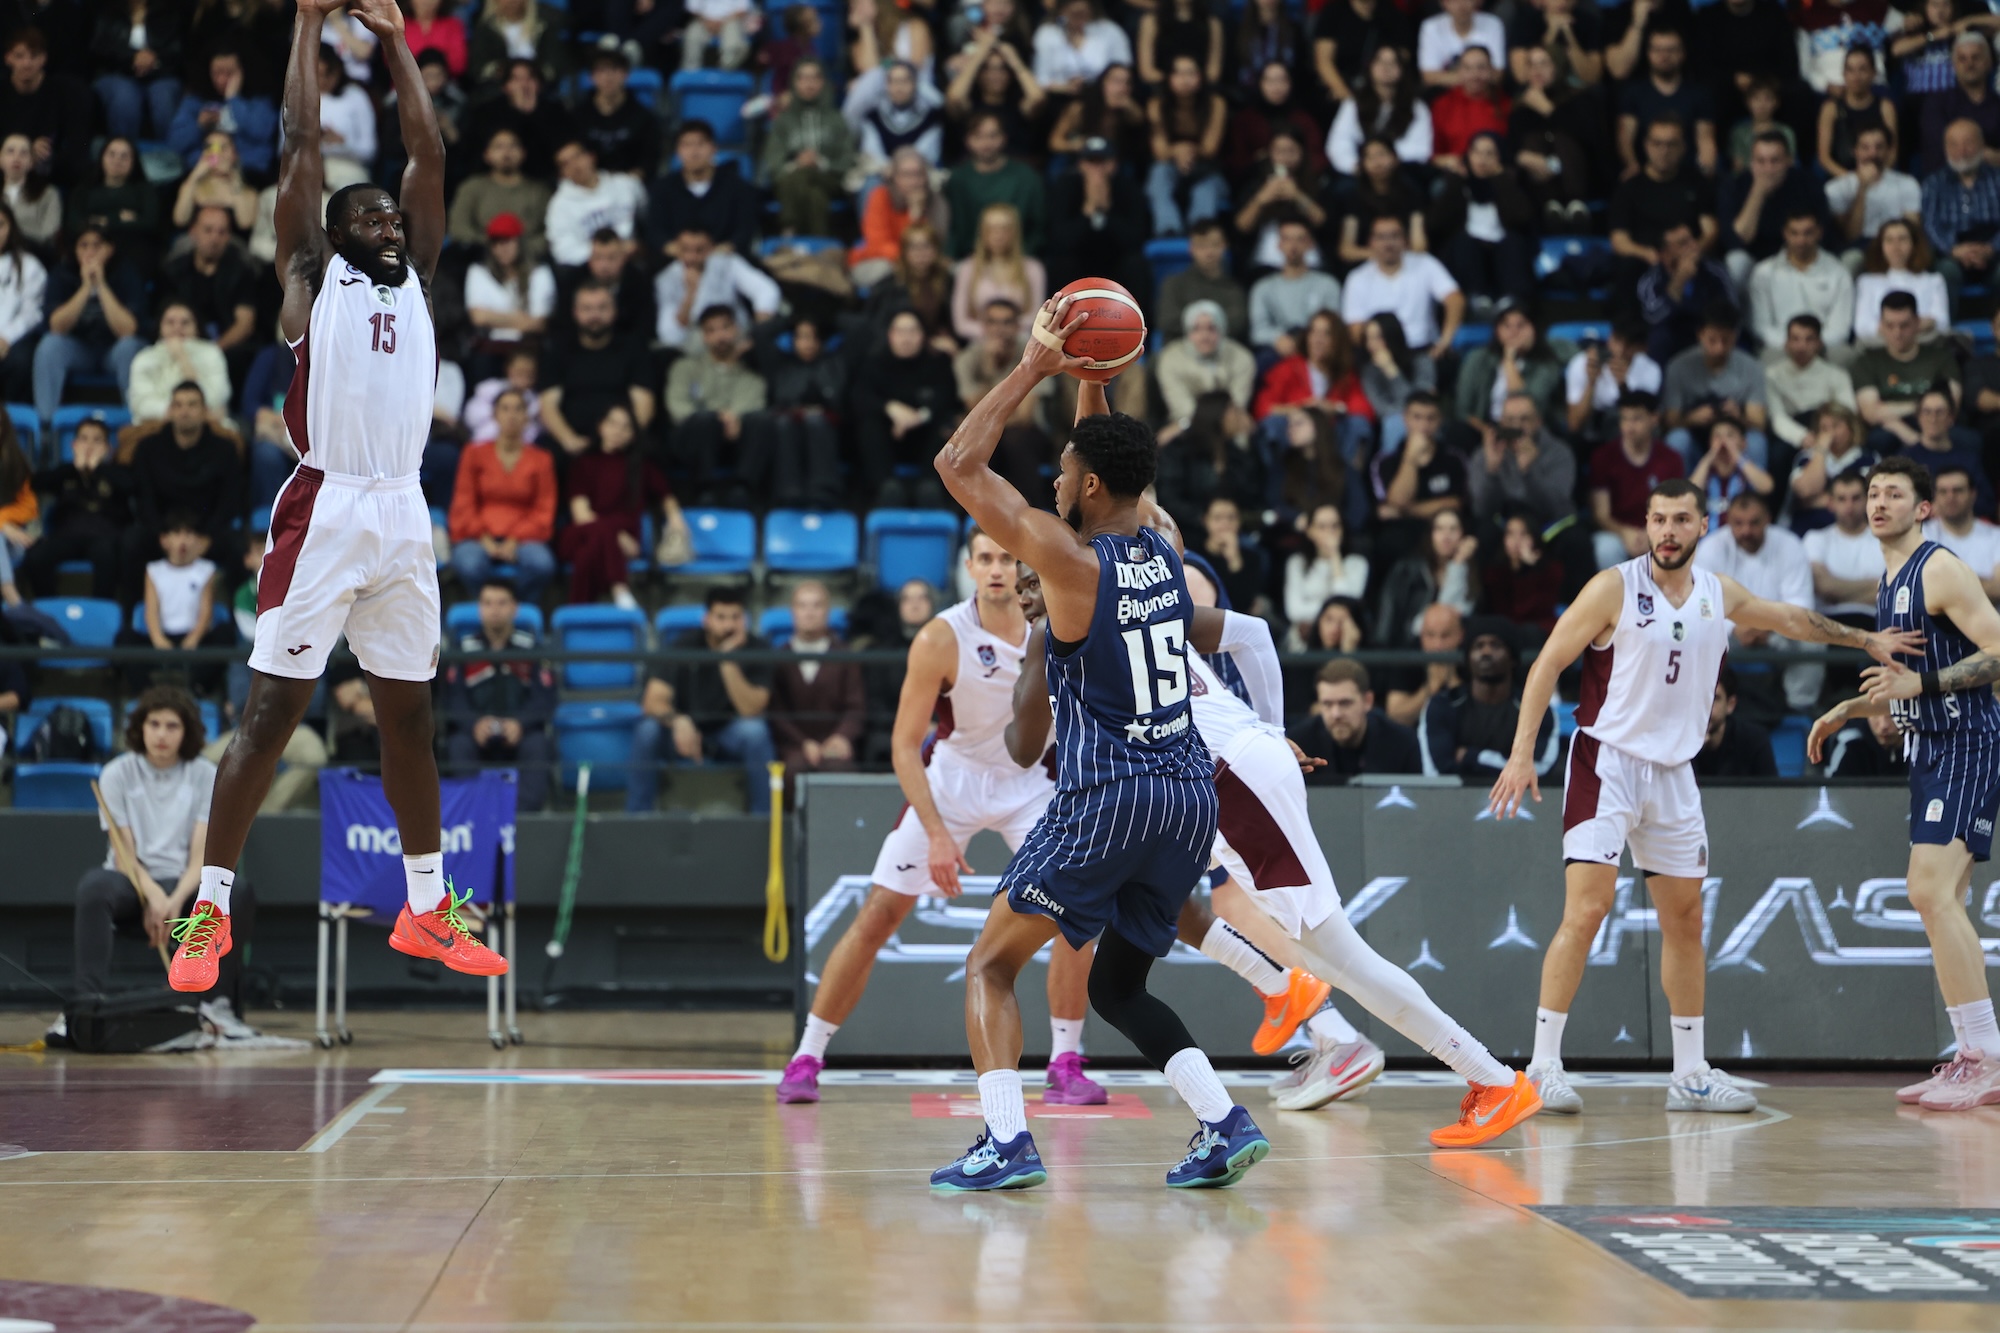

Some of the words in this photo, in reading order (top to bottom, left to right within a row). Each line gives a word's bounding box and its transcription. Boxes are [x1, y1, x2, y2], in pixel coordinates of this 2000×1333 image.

[368, 312, 396, 354] 15
[1121, 619, 1188, 715] 15
[1665, 650, 1682, 684] 5
[1023, 883, 1065, 915] HSM
